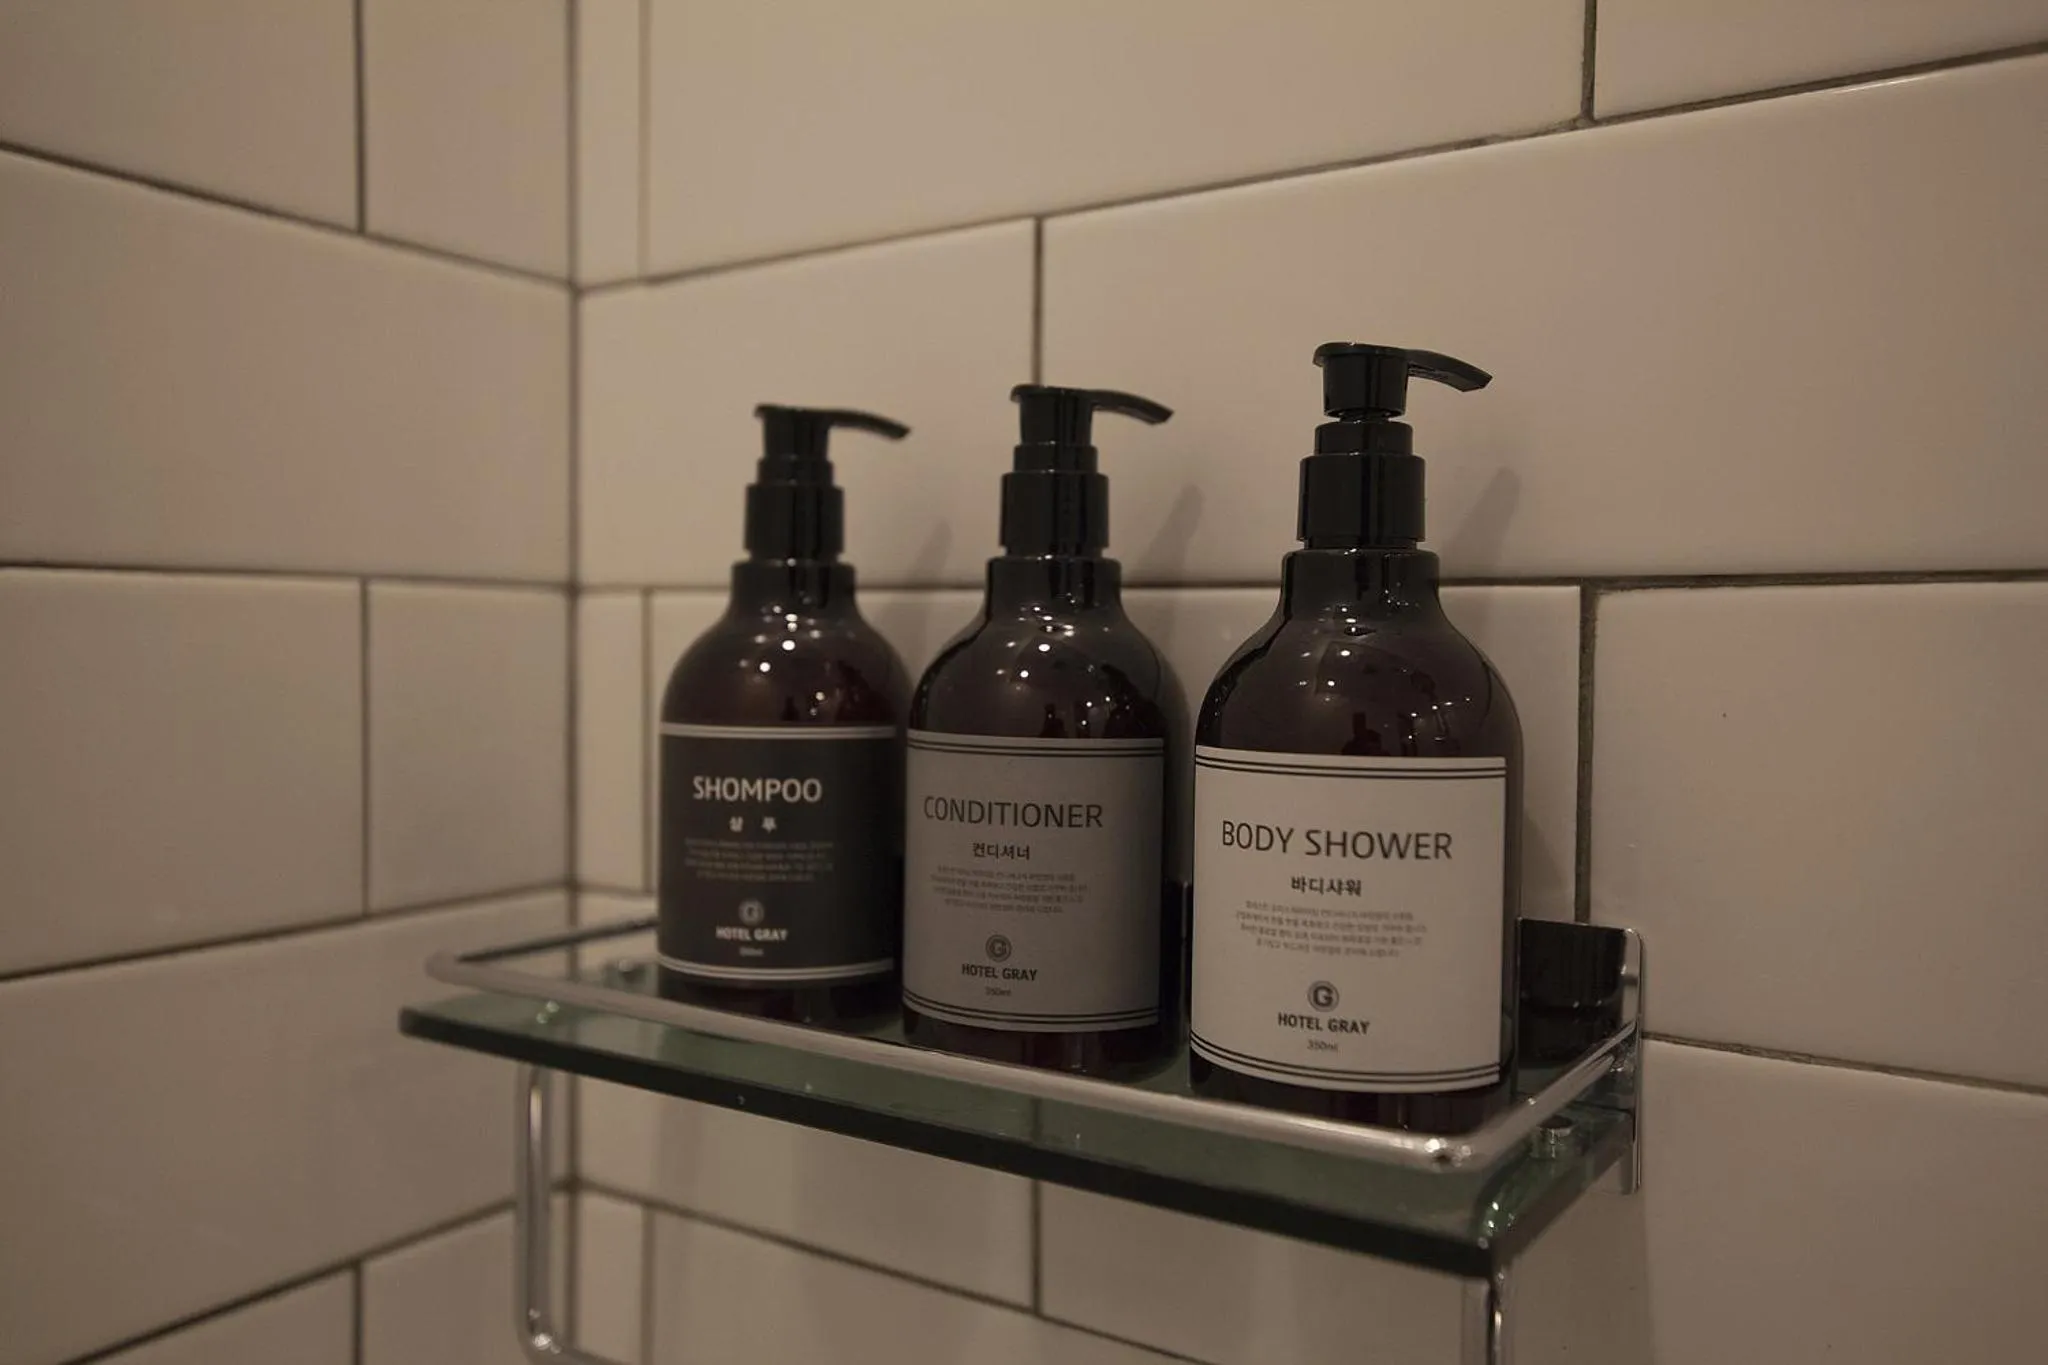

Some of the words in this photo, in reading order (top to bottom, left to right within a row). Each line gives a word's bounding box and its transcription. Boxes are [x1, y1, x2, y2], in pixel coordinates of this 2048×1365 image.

[693, 776, 822, 803] SHOMPOO
[924, 796, 1104, 829] CONDITIONER
[1222, 820, 1294, 854] BODY
[1305, 829, 1453, 860] SHOWER
[1290, 876, 1362, 897] 바디샤워
[716, 926, 751, 941] HOTEL
[754, 928, 789, 942] GRAY
[962, 963, 998, 980] HOTEL
[1002, 967, 1038, 981] GRAY
[1278, 1012, 1322, 1032] HOTEL
[1328, 1018, 1370, 1034] GRAY
